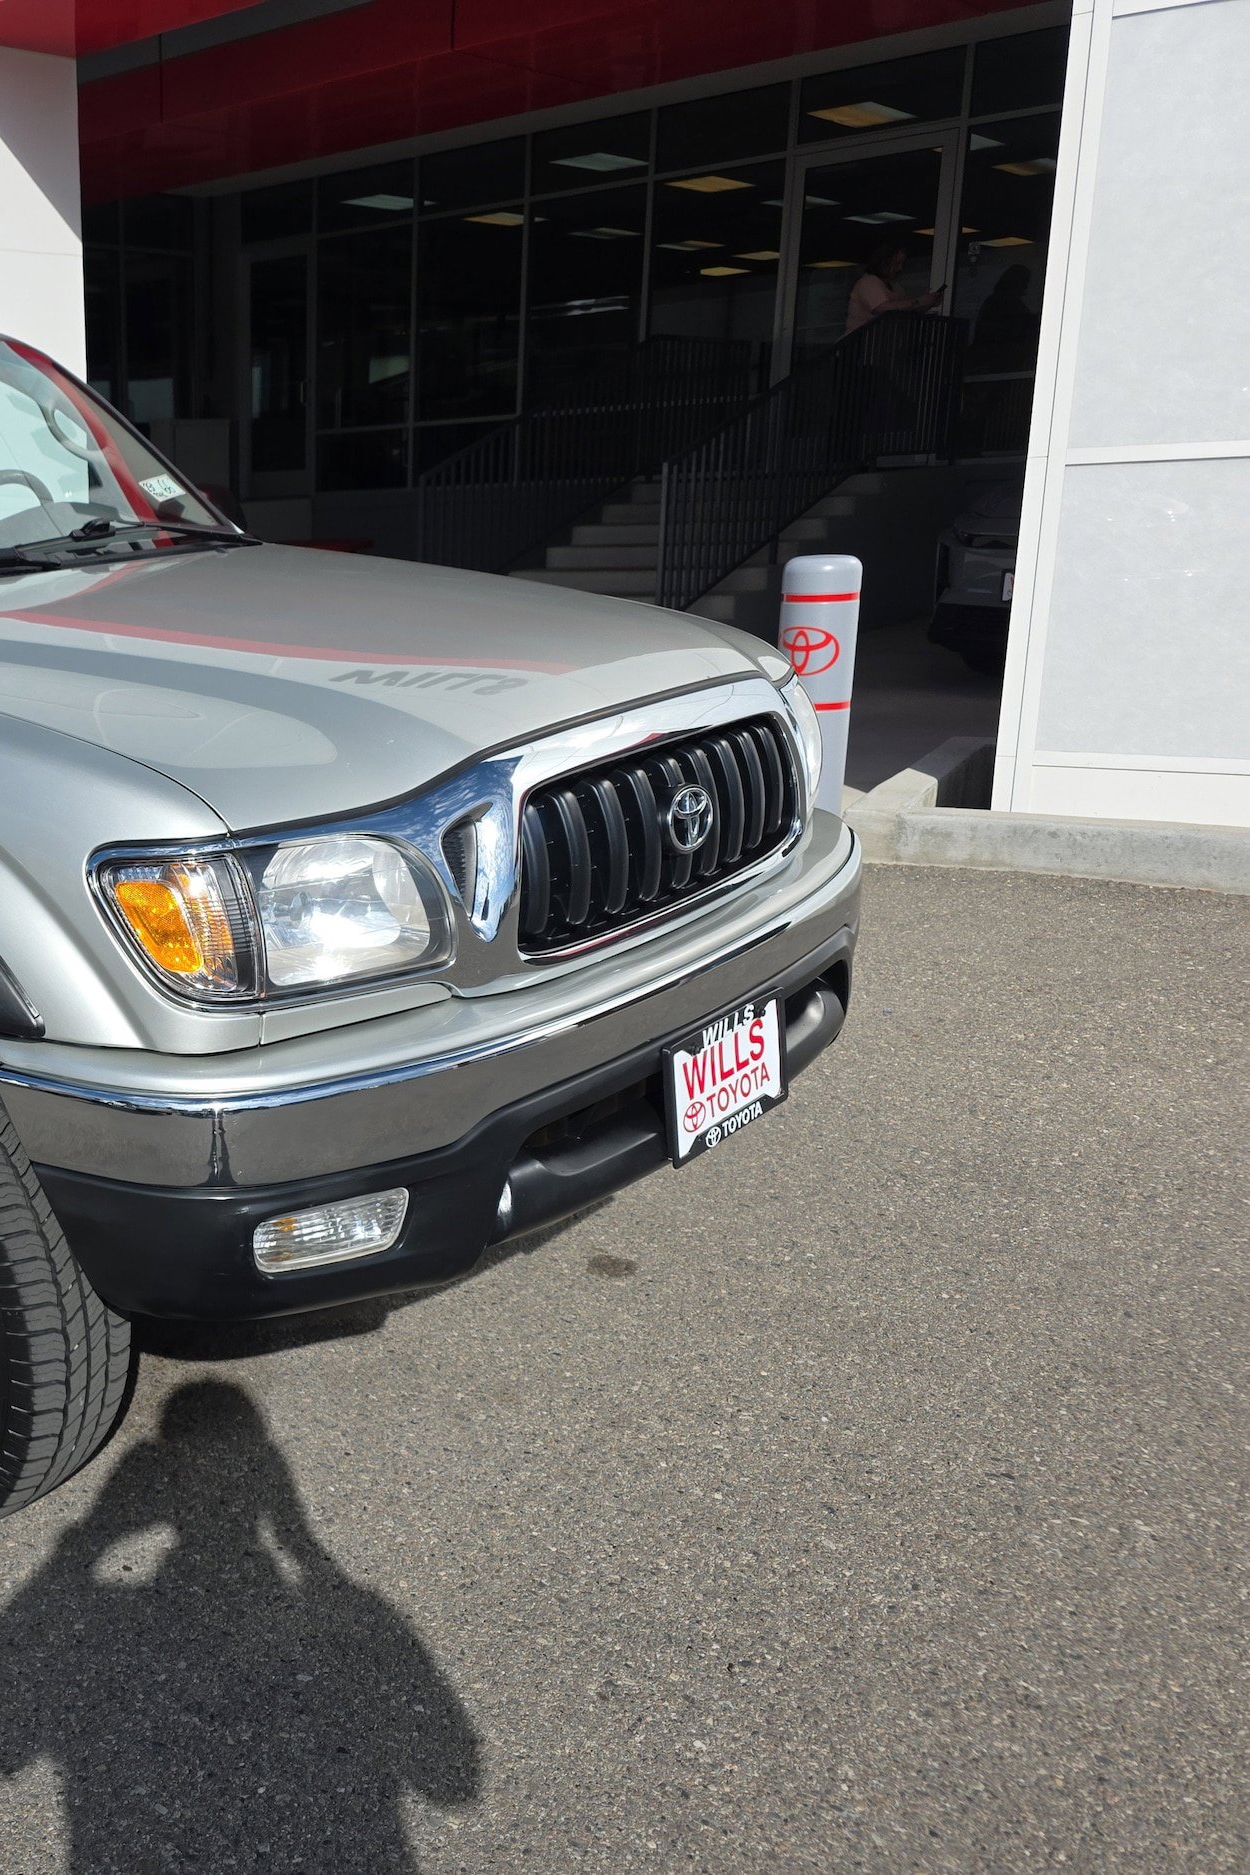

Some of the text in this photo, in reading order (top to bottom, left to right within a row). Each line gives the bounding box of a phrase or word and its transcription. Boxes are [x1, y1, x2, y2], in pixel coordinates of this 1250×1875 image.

[701, 1003, 755, 1049] WILLS
[682, 1018, 765, 1101] WILLS
[706, 1062, 770, 1118] TOYOTA
[721, 1101, 763, 1137] TOYOTA
